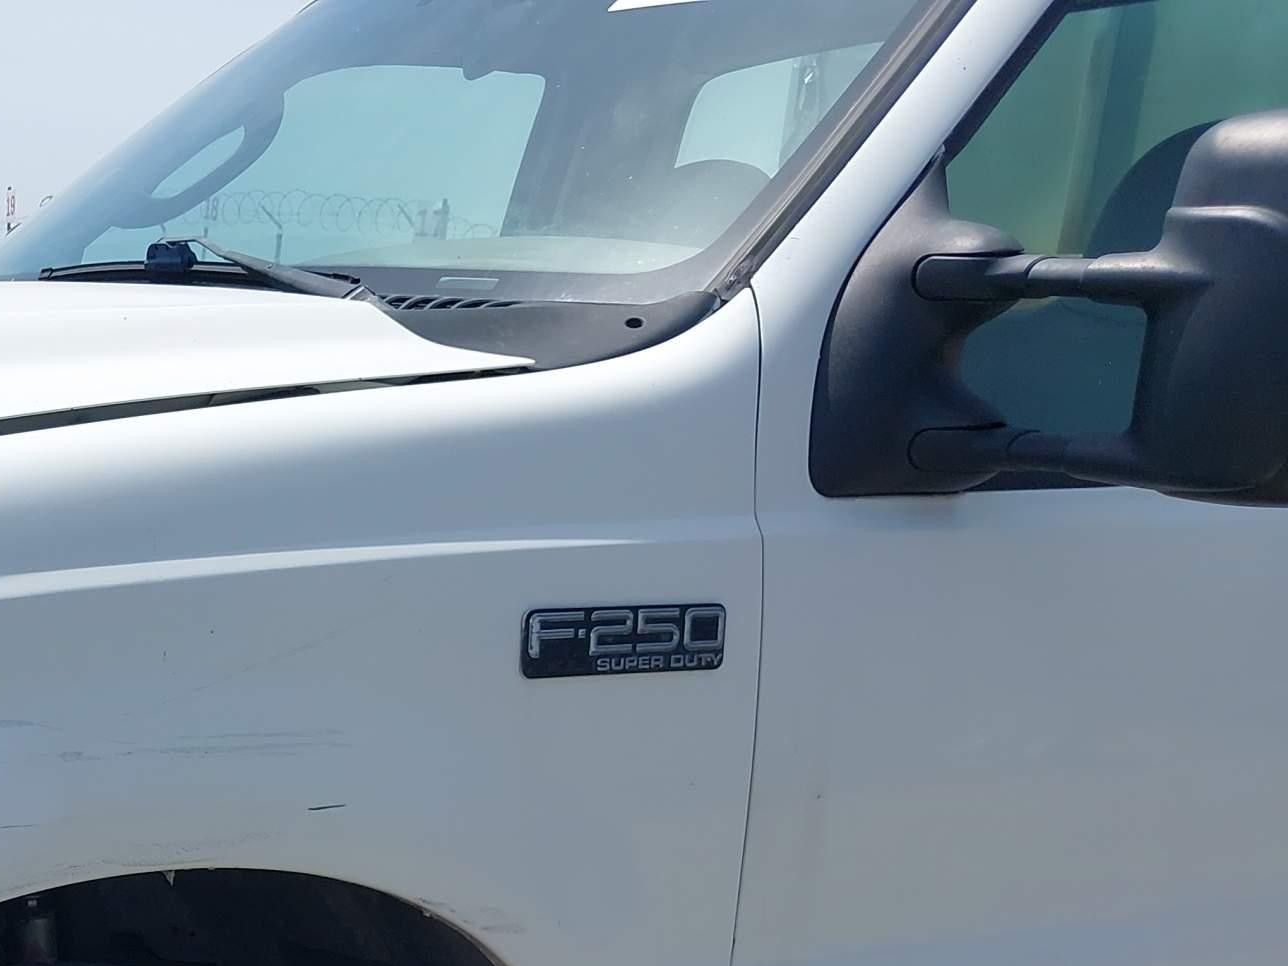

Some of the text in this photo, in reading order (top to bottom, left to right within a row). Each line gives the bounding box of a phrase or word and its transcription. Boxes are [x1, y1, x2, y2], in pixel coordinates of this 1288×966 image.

[528, 607, 725, 659] F-250
[597, 653, 723, 672] SUPER DUTY
